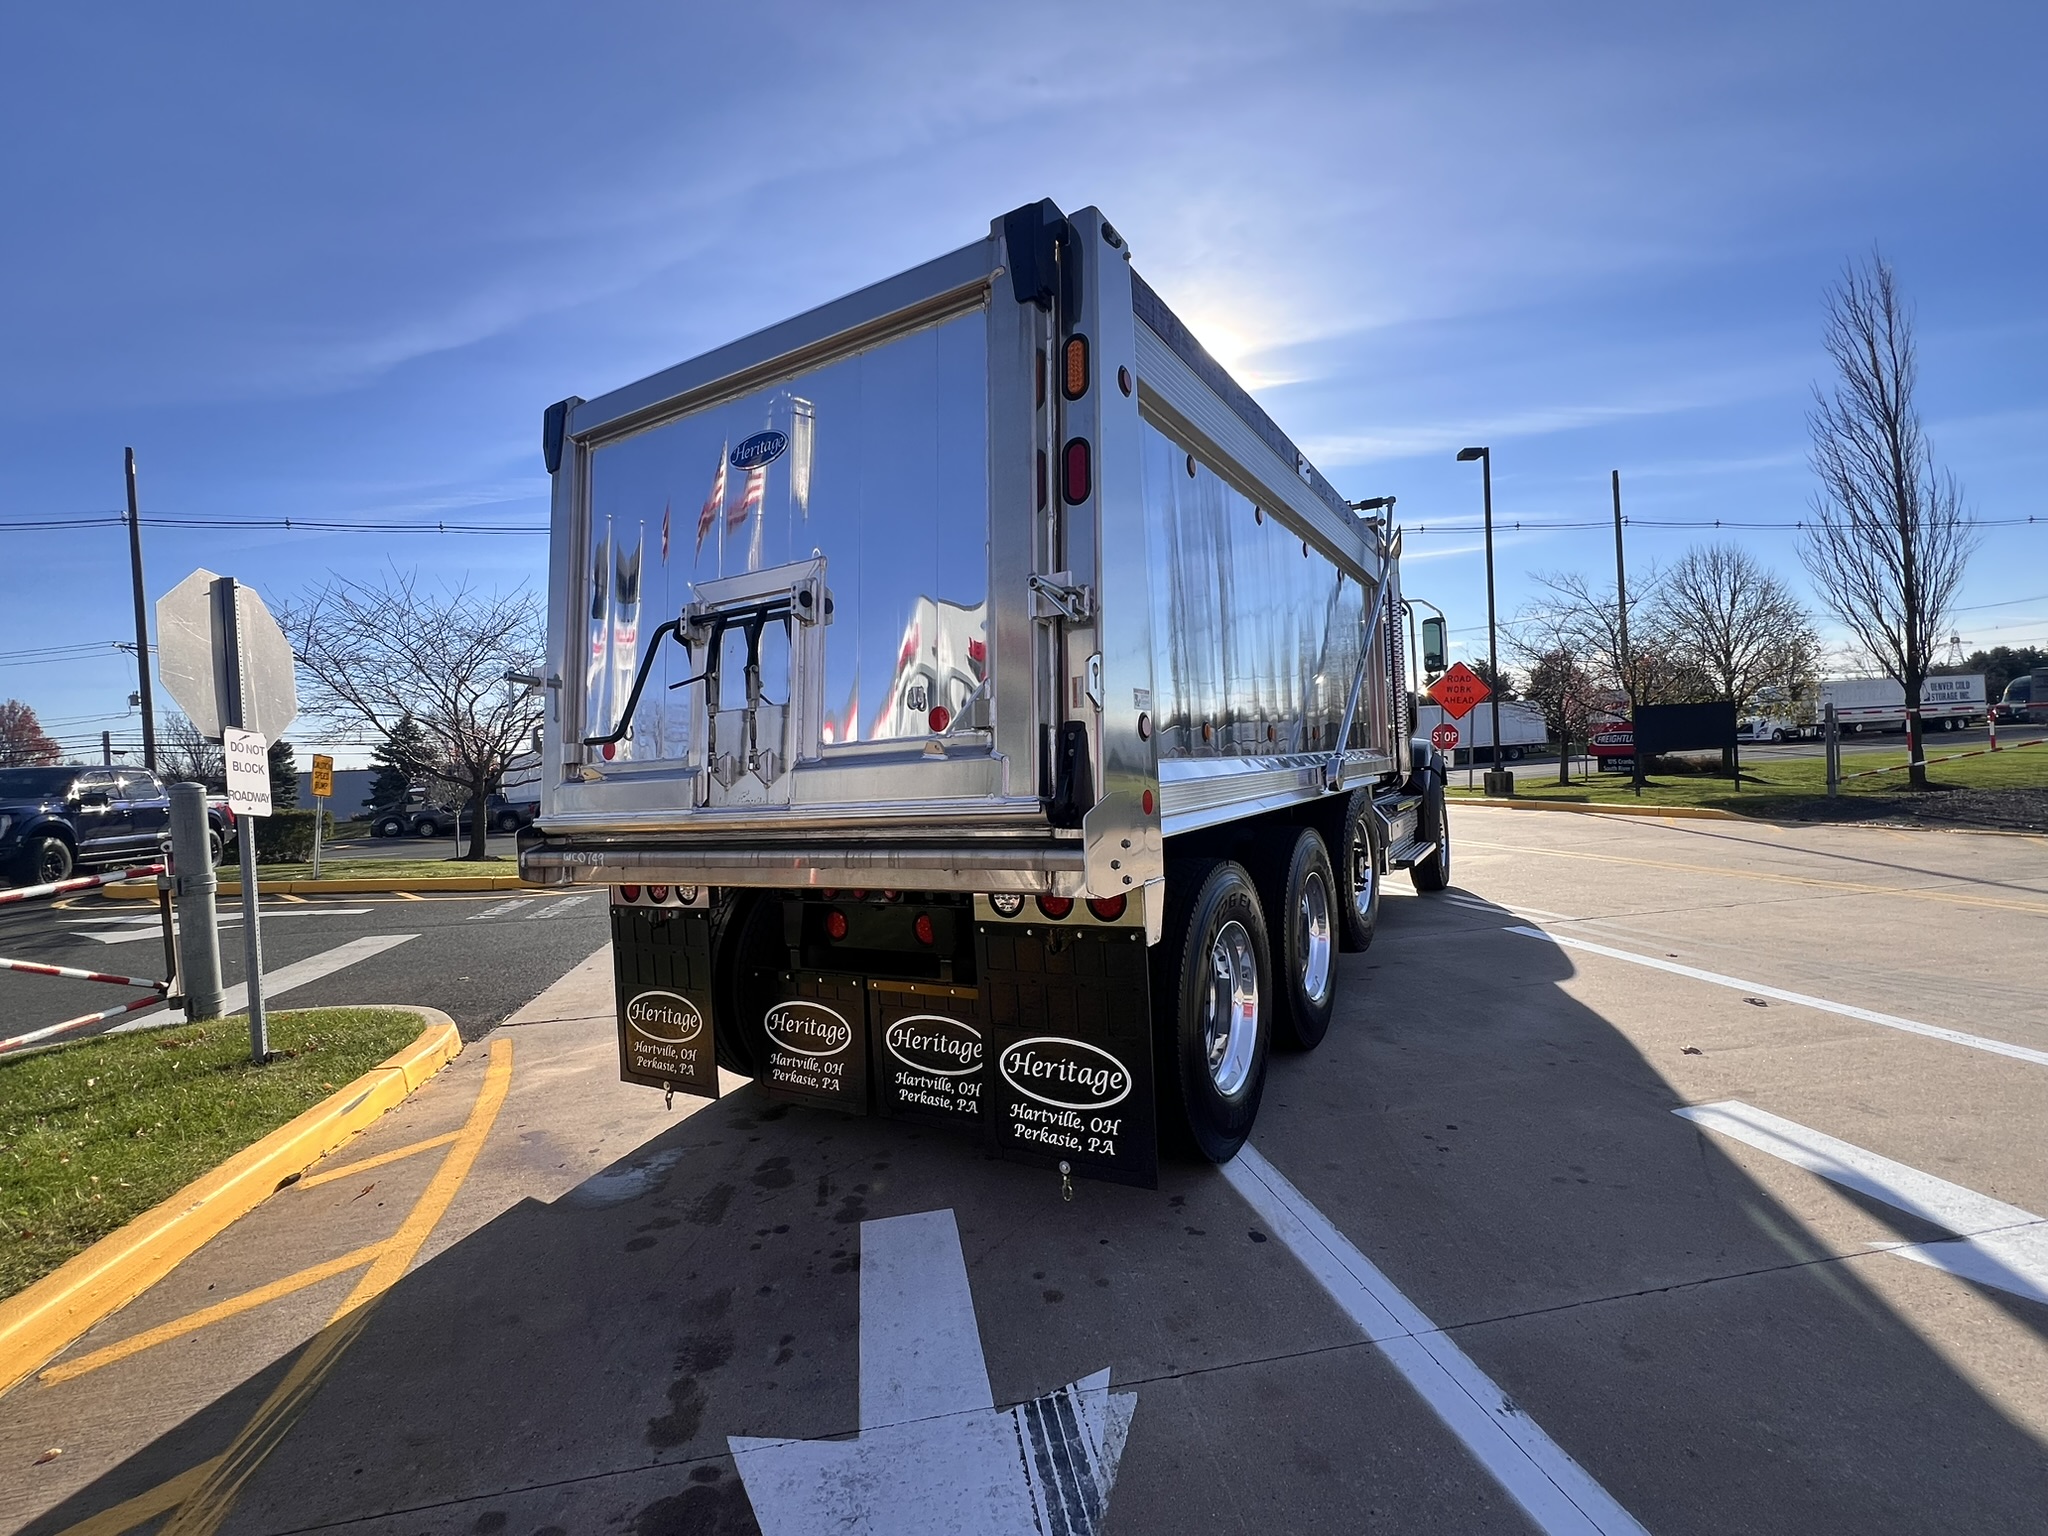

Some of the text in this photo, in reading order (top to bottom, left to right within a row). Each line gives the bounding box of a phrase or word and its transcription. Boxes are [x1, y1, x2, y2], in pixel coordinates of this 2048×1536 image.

[732, 436, 784, 463] Heritage
[1447, 675, 1472, 683] ROAD
[1931, 680, 1970, 691] DENVER COLD
[1443, 696, 1475, 704] AHEAD
[1932, 692, 1958, 701] STORAGE
[230, 741, 265, 757] DO NOT
[1596, 734, 1634, 743] FREIGHTLI
[232, 761, 265, 776] BLOCK
[228, 789, 270, 803] ROADWAY
[631, 1002, 698, 1033] Heritage
[769, 1012, 846, 1046] Heritage
[634, 1041, 698, 1061] Hartville, OH
[892, 1027, 982, 1064] Heritage
[637, 1056, 695, 1076] Perkasie, PA
[770, 1053, 844, 1076] Hartville, OH
[1007, 1051, 1123, 1096] Heritage
[773, 1068, 840, 1091] Perkasie, PA
[895, 1071, 983, 1097] Hartville, OH
[899, 1088, 979, 1114] Perkasie, PA
[1009, 1103, 1122, 1136] Hartville, OH
[1014, 1123, 1116, 1156] Perkasie, PA
